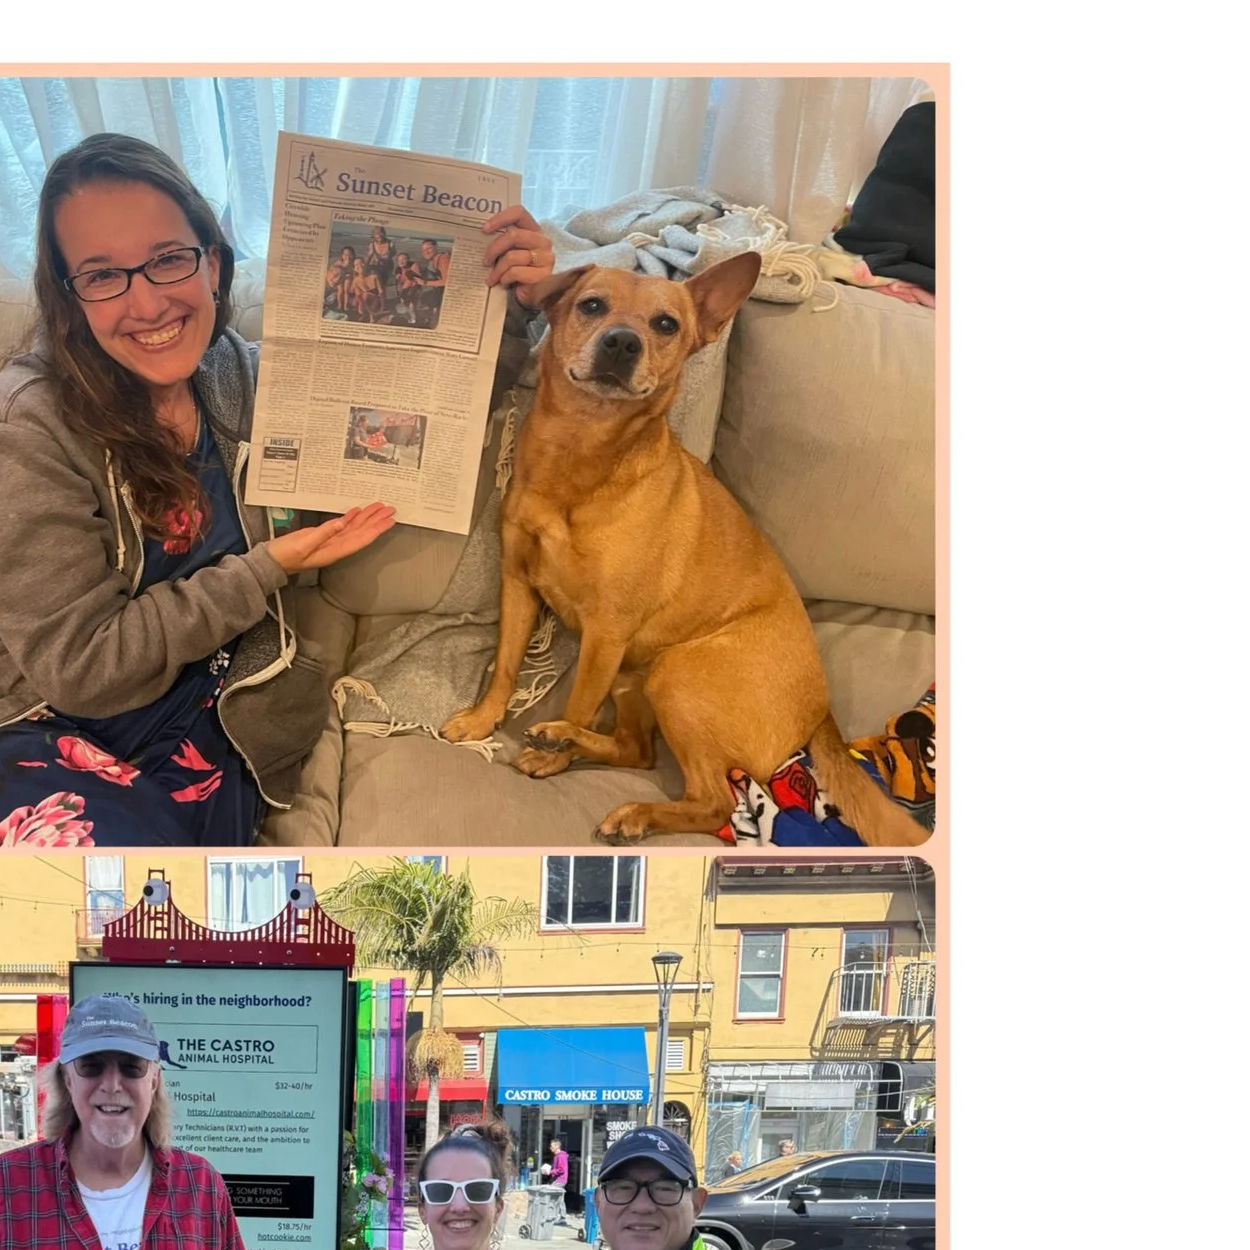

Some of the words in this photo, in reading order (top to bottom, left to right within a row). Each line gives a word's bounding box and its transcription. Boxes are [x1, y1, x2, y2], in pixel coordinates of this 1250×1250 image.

[336, 172, 416, 201] Sunset
[422, 184, 503, 214] Beacon
[143, 993, 179, 1008] hiring
[182, 993, 193, 1005] in
[196, 994, 216, 1006] the
[219, 994, 312, 1009] neighborhood?
[177, 1038, 206, 1051] THE
[211, 1039, 275, 1053] CASTRO
[178, 1054, 219, 1064] ANIMAL
[222, 1054, 275, 1065] HOSPITAL
[275, 1080, 313, 1091] $32-40/hr
[174, 1092, 216, 1103] Hospital
[505, 1089, 550, 1101] CASTRO
[555, 1089, 598, 1101] SMOKE
[602, 1089, 644, 1101] HOUSE
[187, 1108, 316, 1120] https://castroanimalhospital.com/
[185, 1124, 225, 1132] Technicians
[248, 1125, 263, 1133] with
[270, 1126, 297, 1135] passion
[298, 1126, 309, 1134] for
[606, 1121, 638, 1131] SMOKE
[203, 1134, 223, 1142] client
[242, 1135, 256, 1143] and
[257, 1135, 268, 1143] the
[270, 1136, 301, 1144] ambition
[207, 1145, 244, 1153] healthcare
[236, 1187, 283, 1196] SOMETHING
[233, 1196, 253, 1204] YOUR
[255, 1197, 283, 1205] MOUTH
[278, 1222, 312, 1231] $18.75/hr
[257, 1233, 312, 1242] hotcookie.com
